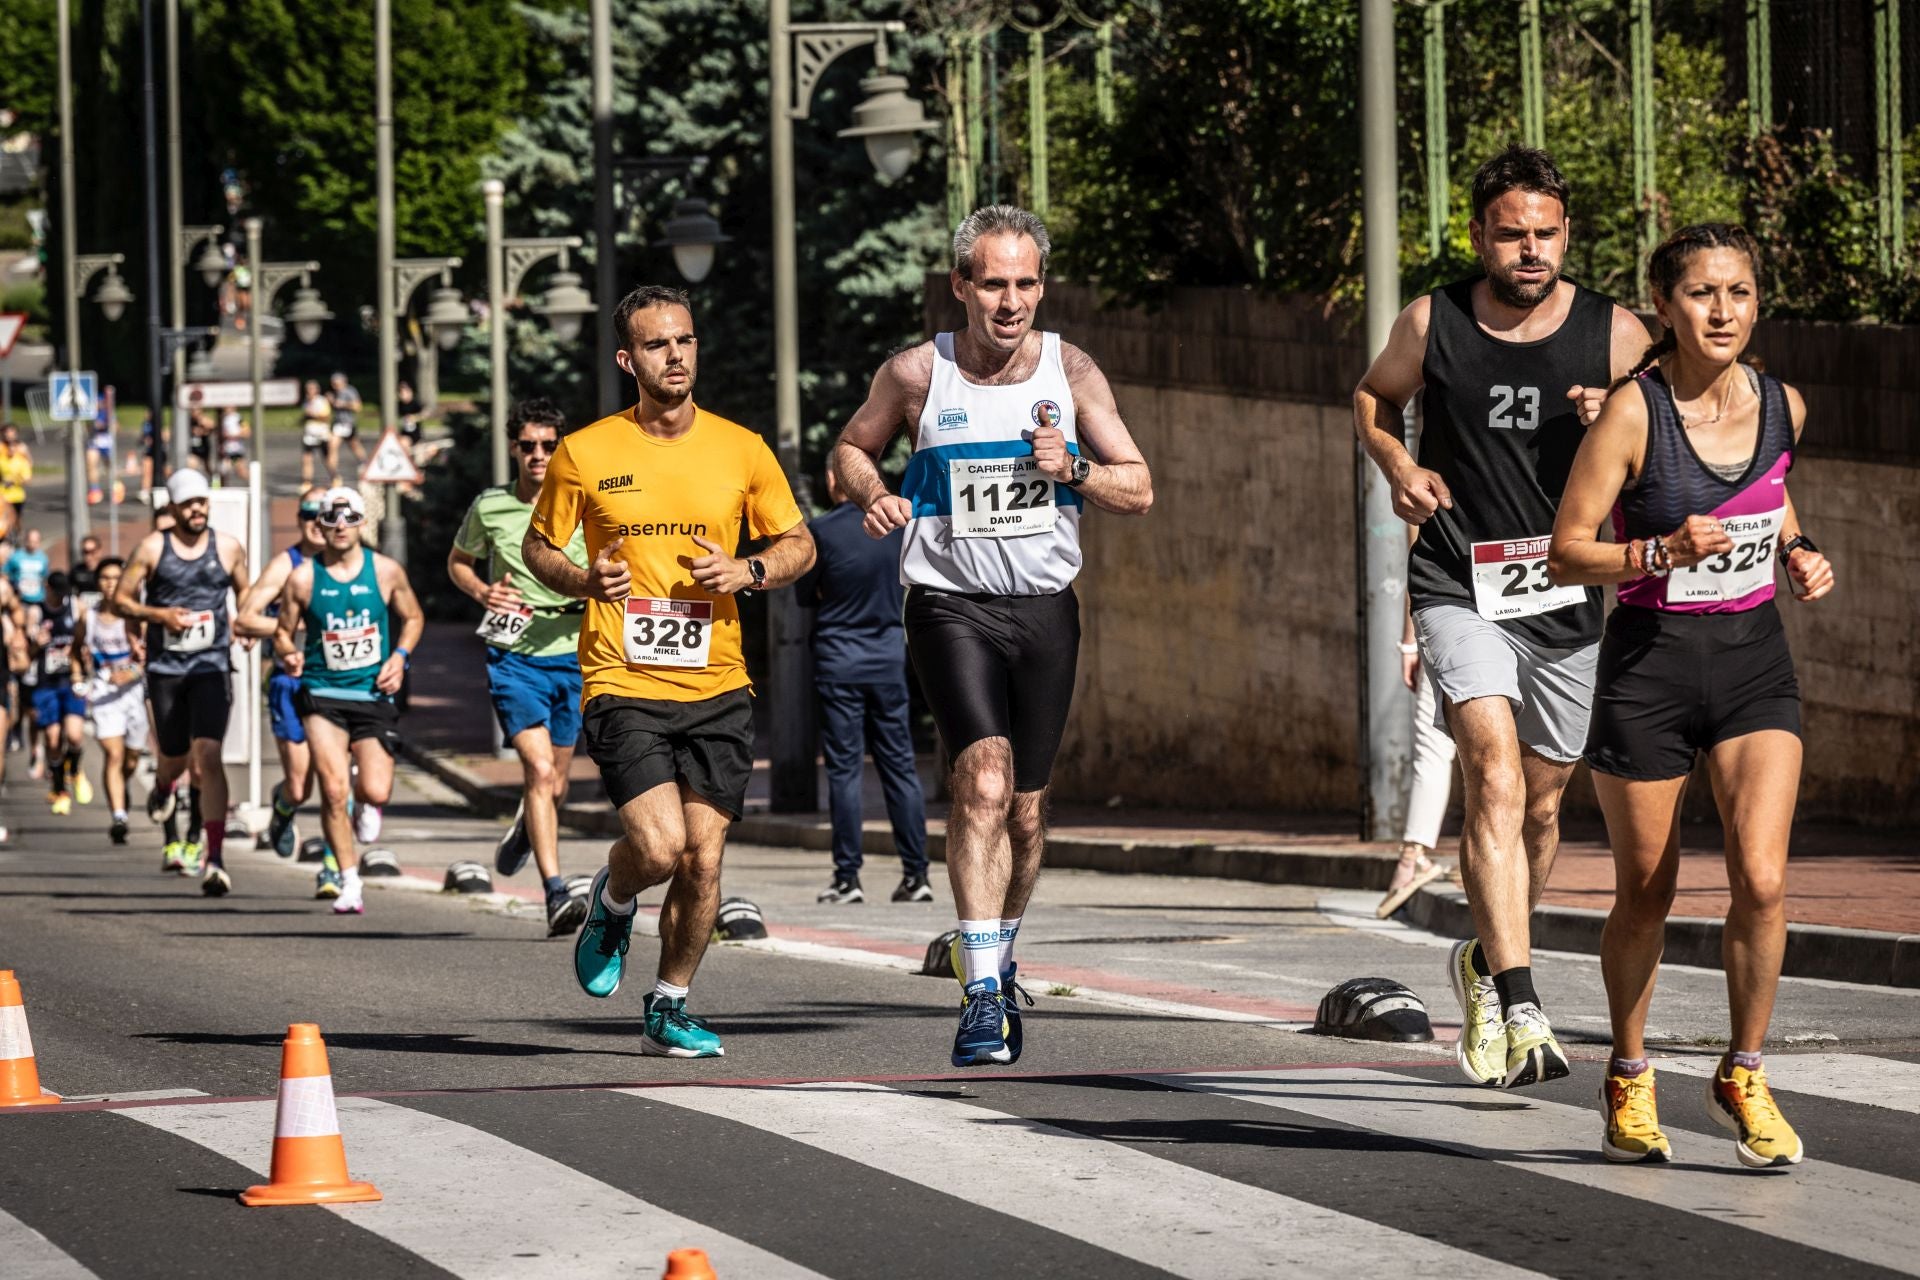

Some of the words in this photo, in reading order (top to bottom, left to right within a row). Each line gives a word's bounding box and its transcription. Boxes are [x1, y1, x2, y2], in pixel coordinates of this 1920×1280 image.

[1489, 385, 1540, 430] 23
[938, 411, 968, 426] LAGUNA
[968, 463, 1024, 473] CARRERA
[598, 474, 633, 491] ASELAN
[960, 480, 1049, 512] 1122
[990, 515, 1022, 525] DAVID
[618, 523, 706, 536] asenrun
[633, 617, 702, 649] 328
[332, 639, 373, 659] 373
